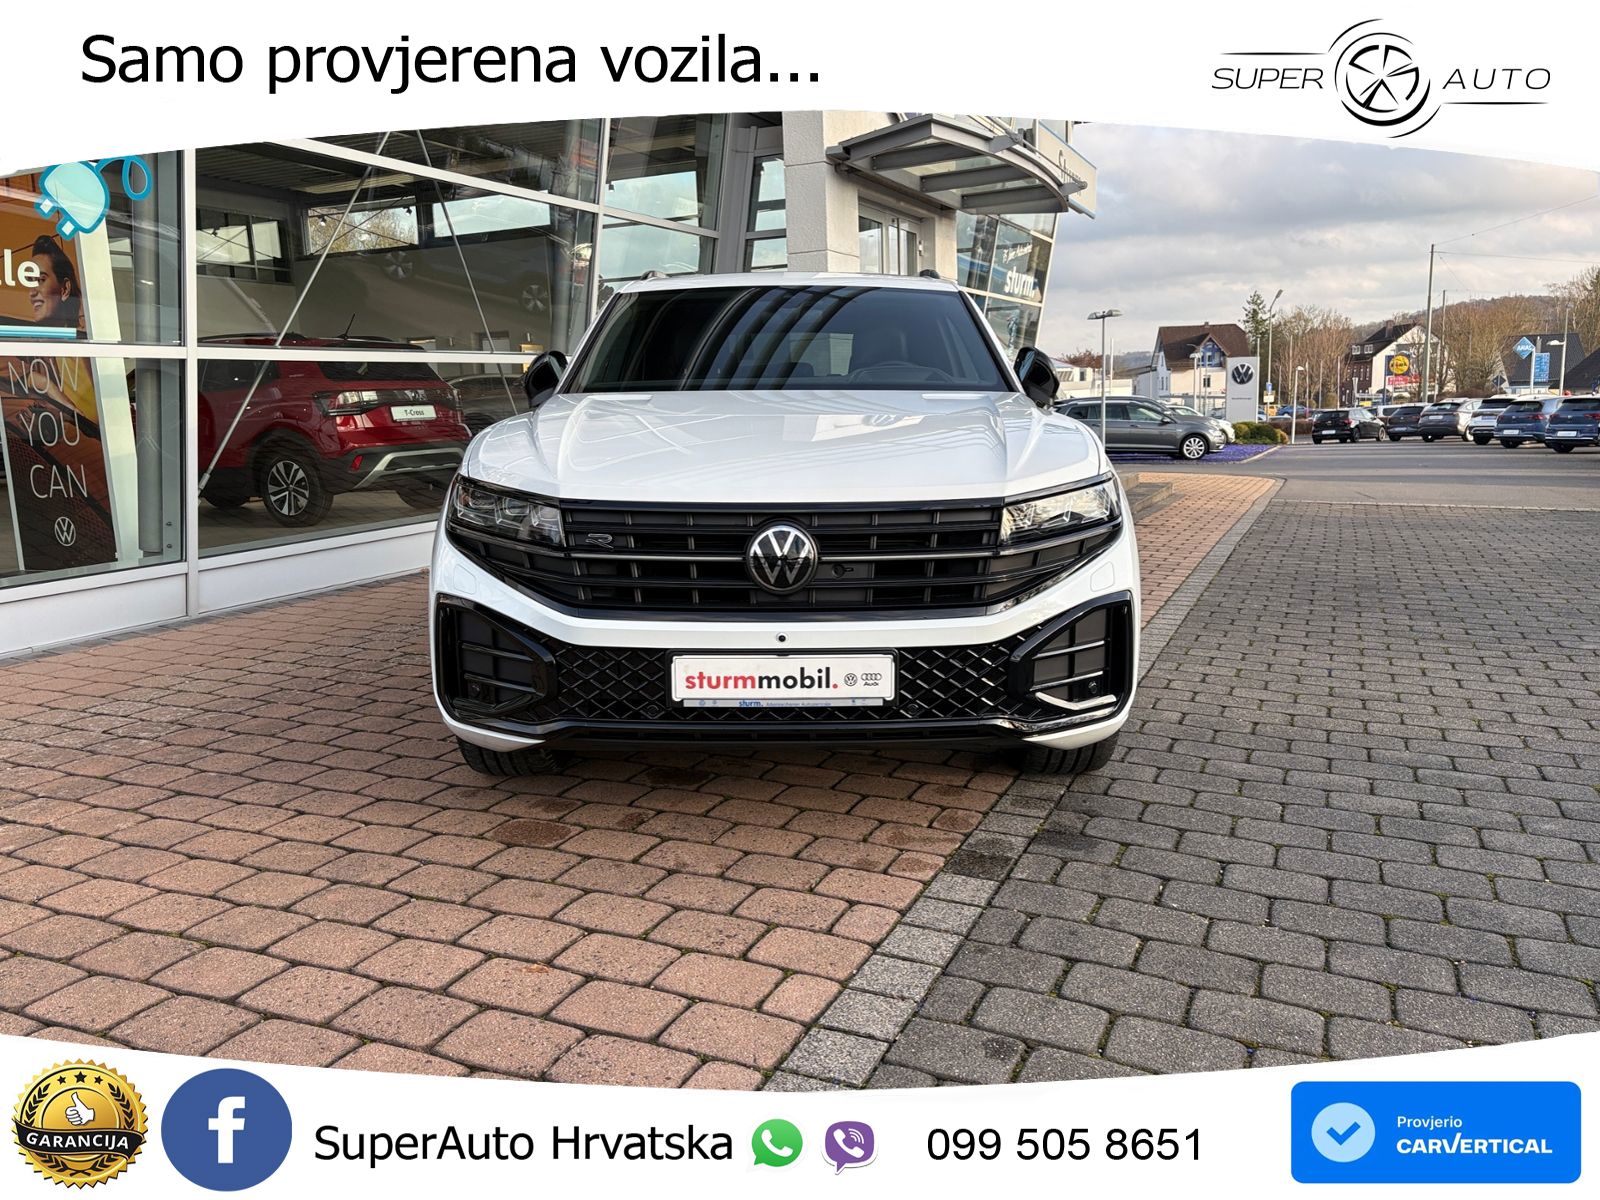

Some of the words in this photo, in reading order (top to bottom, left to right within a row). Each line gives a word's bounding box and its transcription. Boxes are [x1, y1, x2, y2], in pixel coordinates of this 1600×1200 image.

[0, 249, 40, 288] le
[8, 356, 80, 394] NOW
[19, 410, 81, 447] YOU
[404, 408, 425, 416] T-Cross
[30, 463, 89, 499] CAN
[685, 666, 839, 690] sturmmobil.
